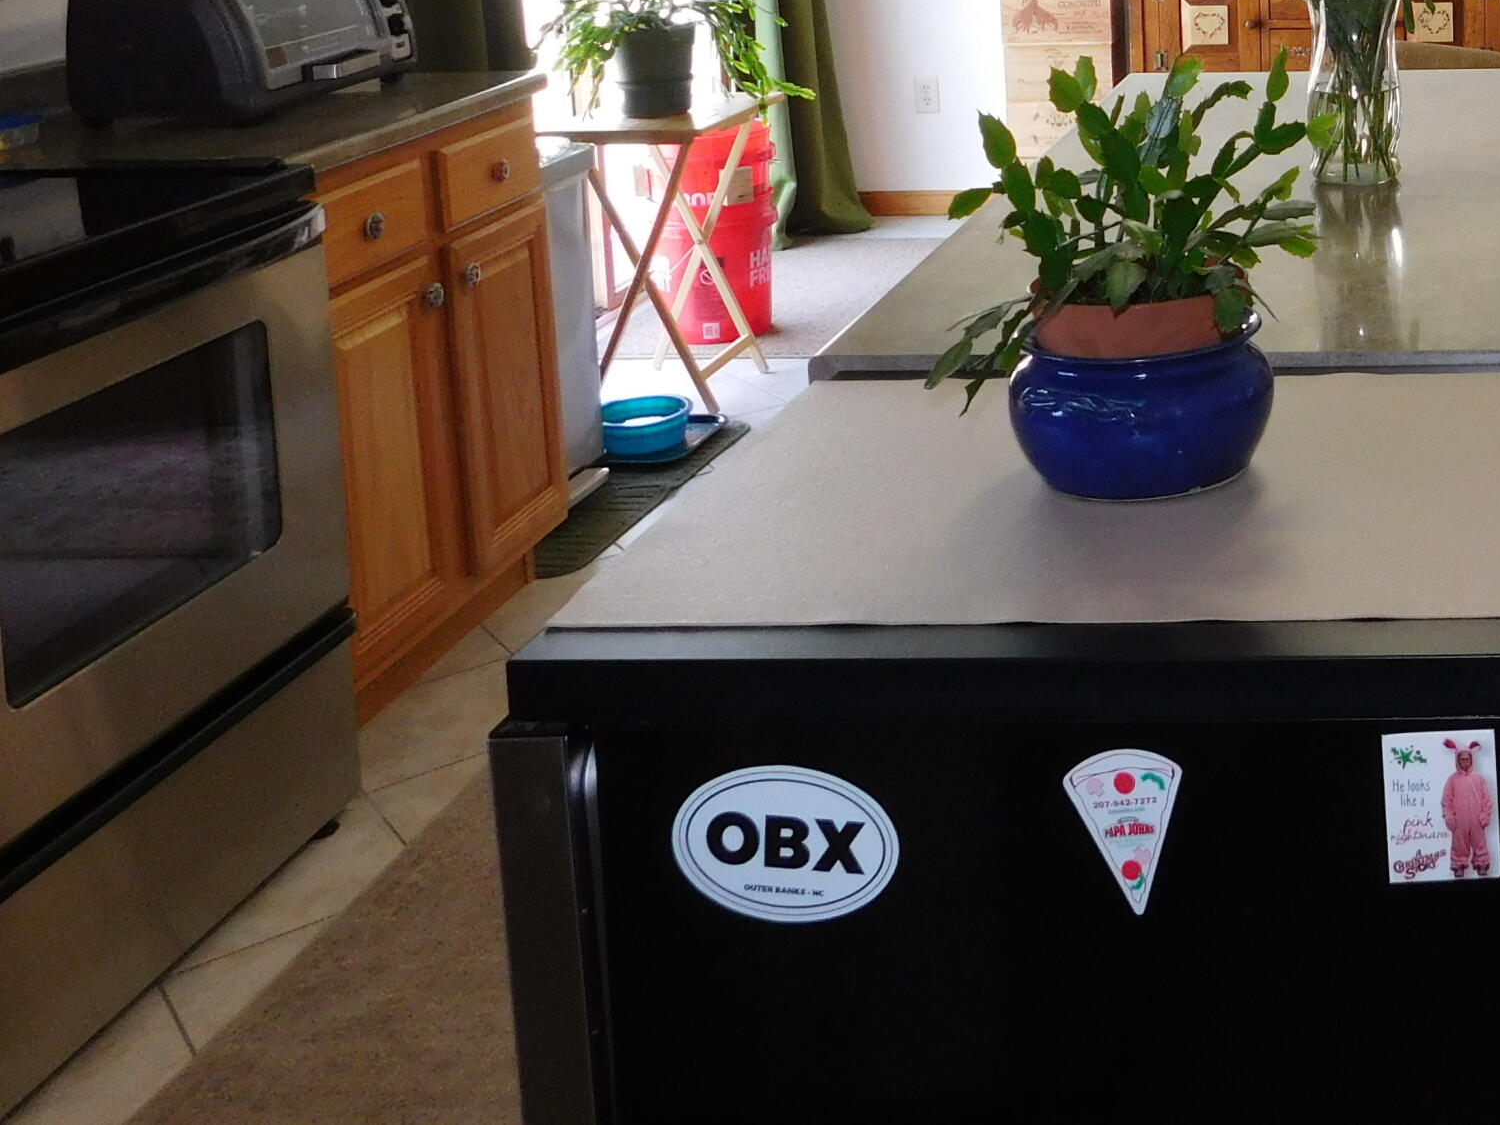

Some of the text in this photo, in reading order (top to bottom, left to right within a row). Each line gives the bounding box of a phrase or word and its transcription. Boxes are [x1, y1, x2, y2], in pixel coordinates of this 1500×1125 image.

[1392, 778, 1431, 793] He looks
[1400, 794, 1417, 807] like
[1104, 823, 1127, 838] PAPA
[1402, 810, 1434, 836] pink
[706, 810, 866, 875] OBX
[743, 884, 773, 893] OUTER
[774, 886, 806, 896] BANKS
[812, 889, 824, 897] NC
